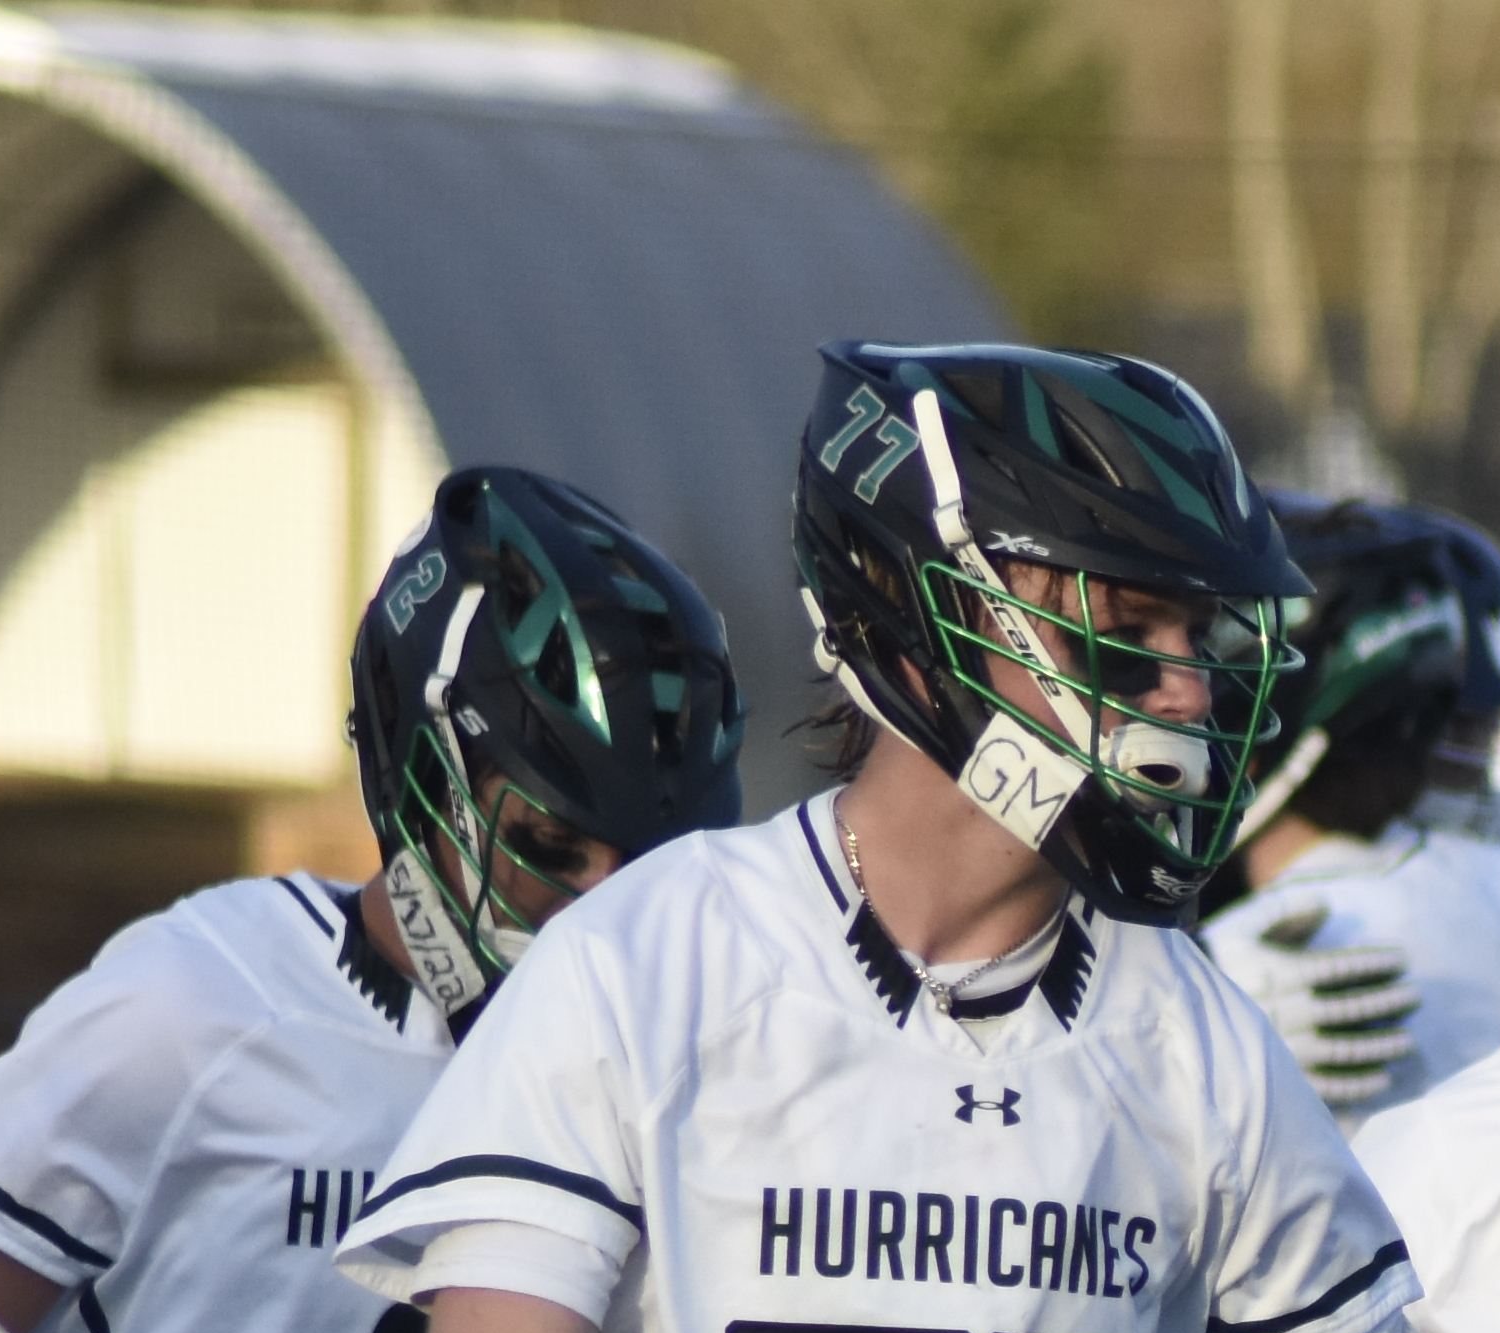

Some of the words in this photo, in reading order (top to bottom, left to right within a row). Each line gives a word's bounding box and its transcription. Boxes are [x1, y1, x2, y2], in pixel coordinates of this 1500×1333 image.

[820, 383, 920, 505] 77
[967, 737, 1069, 843] GM
[759, 1187, 1157, 1299] HURRICANES
